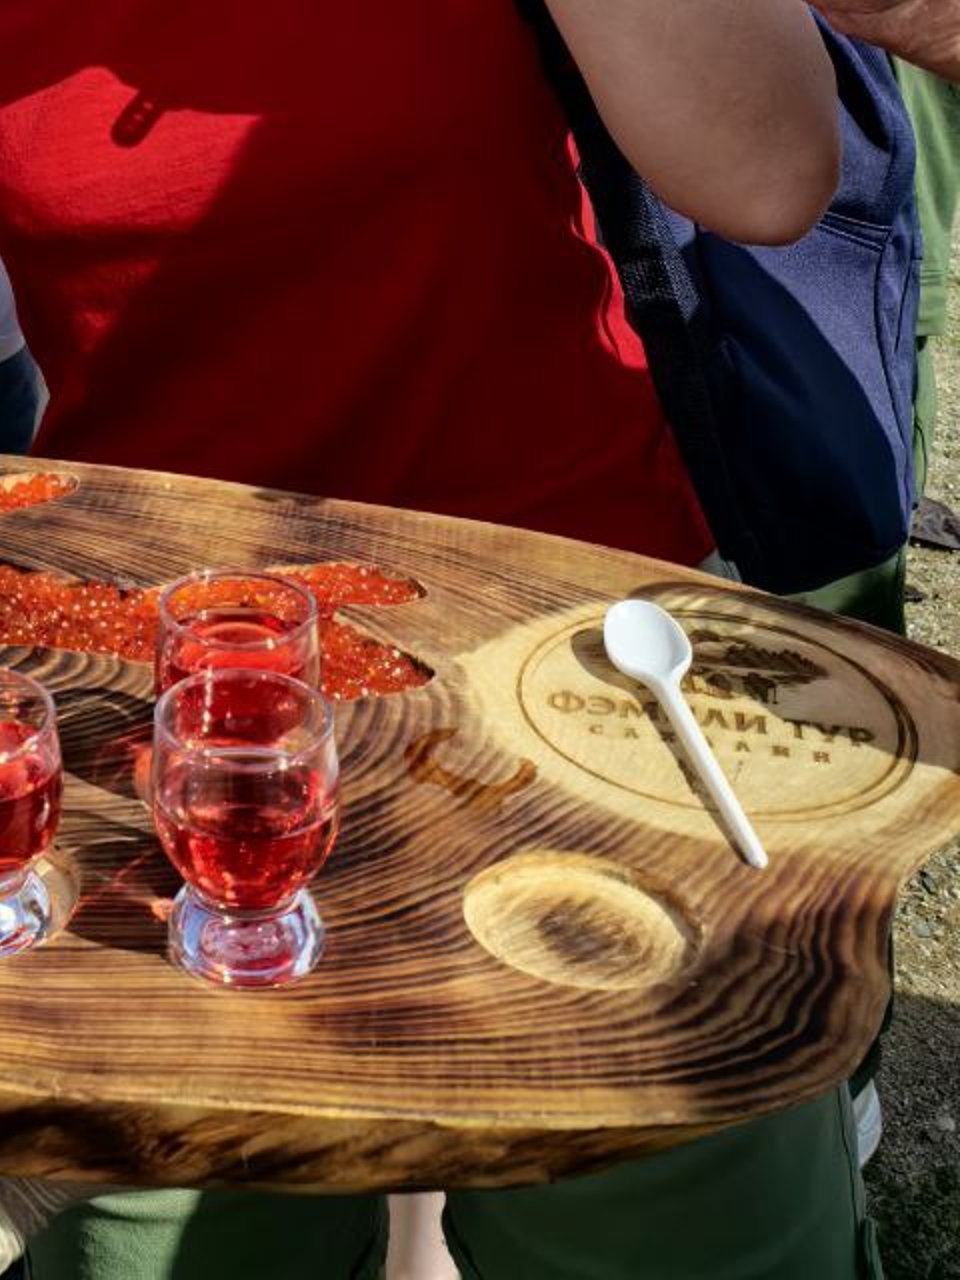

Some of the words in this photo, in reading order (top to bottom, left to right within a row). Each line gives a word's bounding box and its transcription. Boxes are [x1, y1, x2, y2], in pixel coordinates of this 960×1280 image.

[547, 689, 768, 735] ФЭМЛИ
[782, 718, 875, 747] ТУР
[589, 723, 831, 763] САХЛИН
